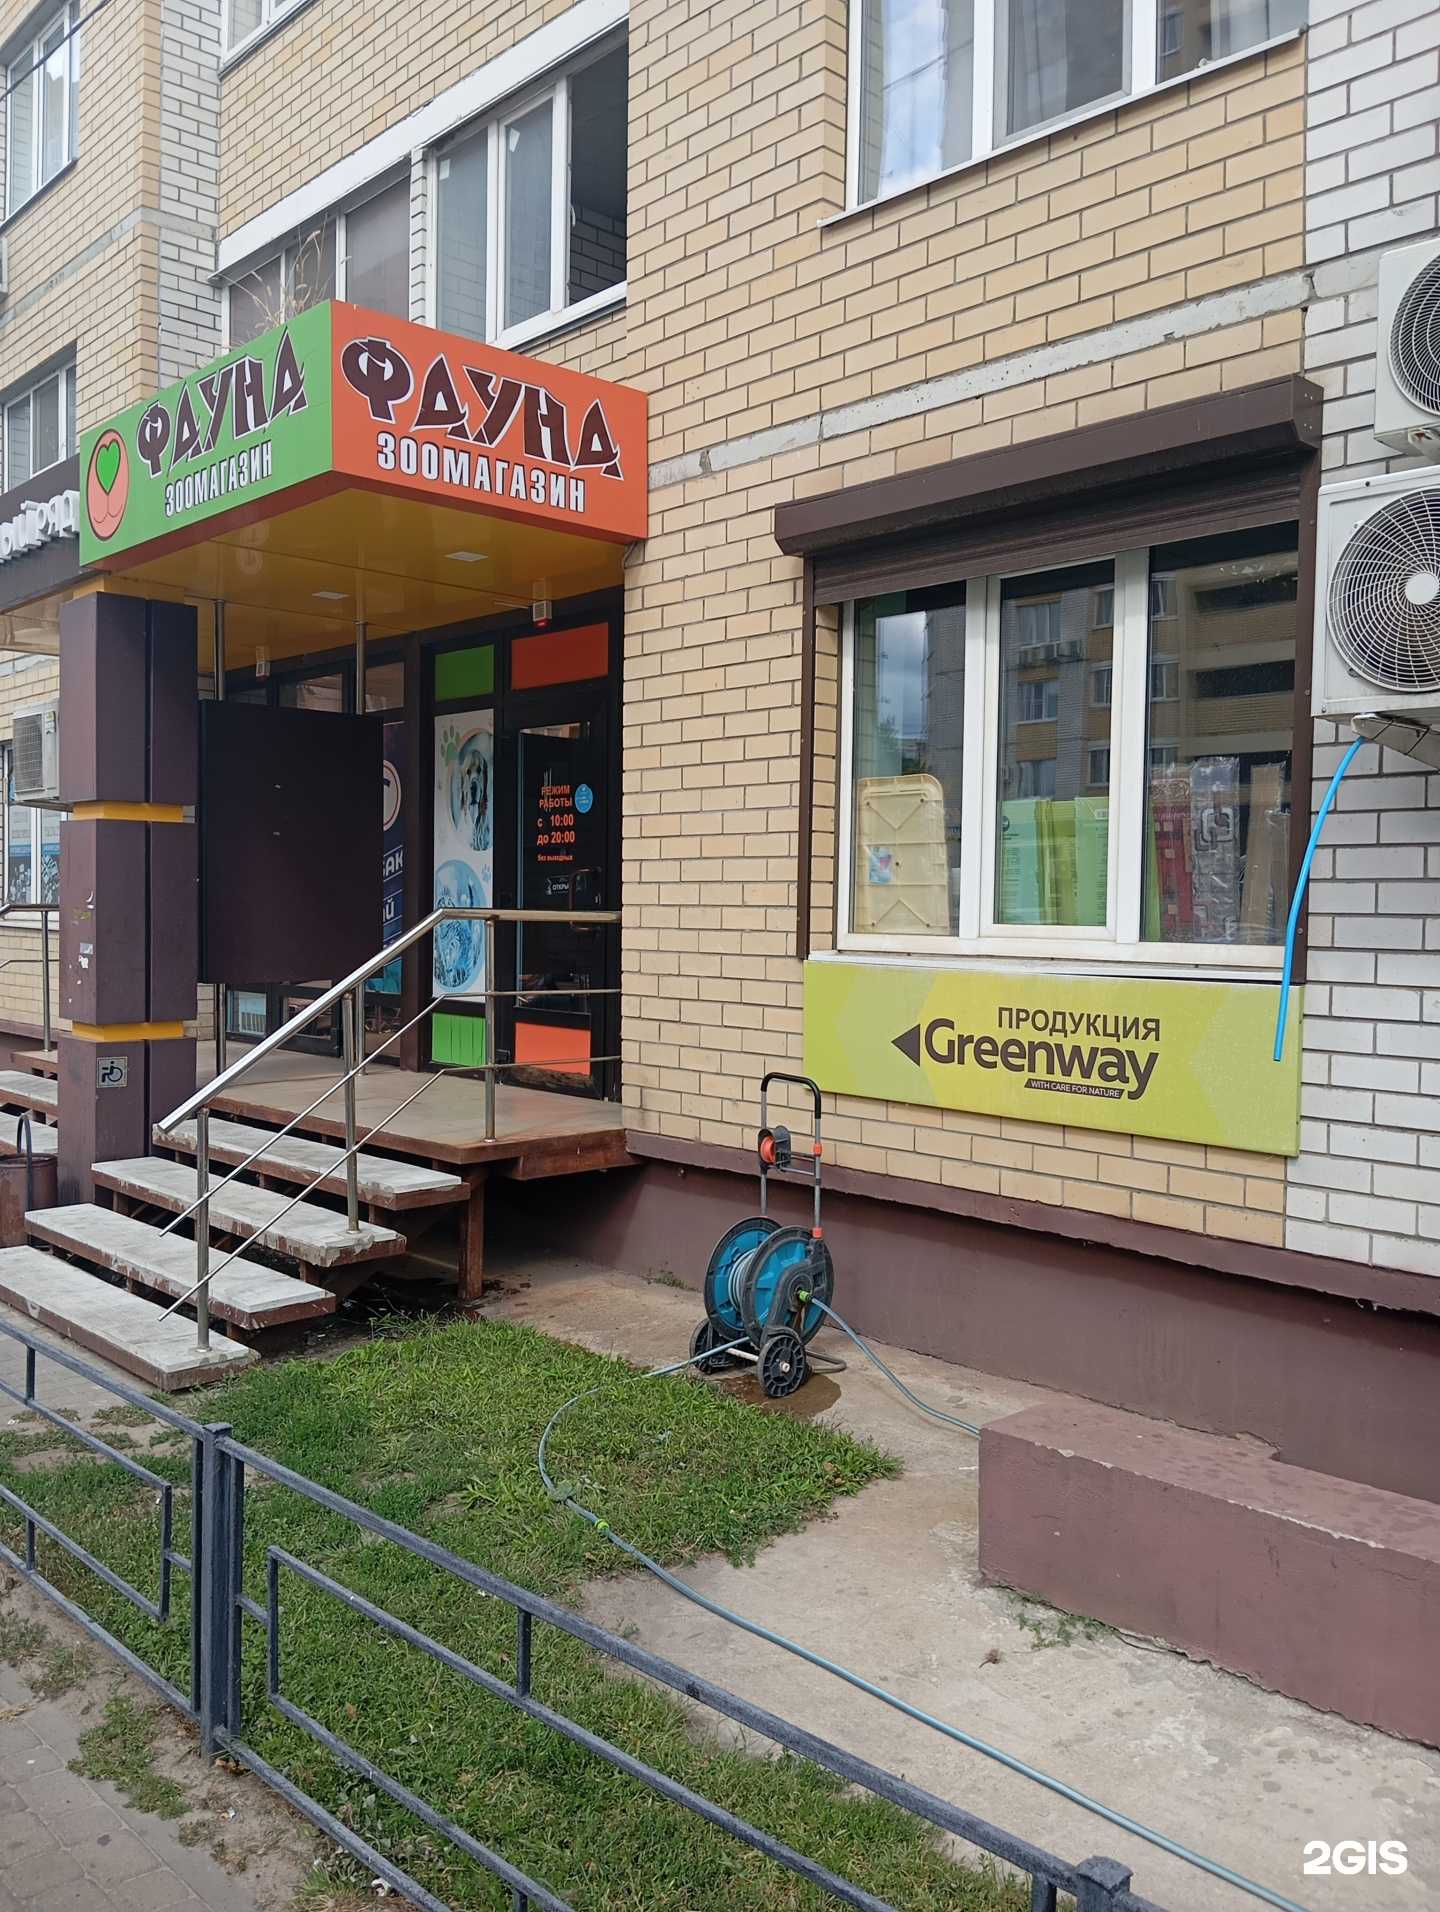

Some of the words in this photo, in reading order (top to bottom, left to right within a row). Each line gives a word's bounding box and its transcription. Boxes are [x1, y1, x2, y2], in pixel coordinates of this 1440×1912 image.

[137, 326, 308, 479] ФАУНА
[341, 335, 624, 480] ФАУНА
[165, 439, 272, 517] ЗООМАГАЗИН
[376, 431, 585, 513] ЗООМАГАЗИН
[539, 798, 572, 809] РАБОТЫ
[541, 785, 570, 795] РЕЖИМ
[537, 834, 549, 845] до
[551, 831, 575, 843] 20:00
[550, 814, 574, 827] 10:00
[998, 1006, 1160, 1042] ПРОДУКЦИЯ
[924, 1018, 1159, 1100] Greenway
[1031, 1081, 1049, 1089] WITH
[1051, 1083, 1071, 1091] CARE
[1071, 1085, 1088, 1094] FOR
[1089, 1087, 1120, 1097] NATURE
